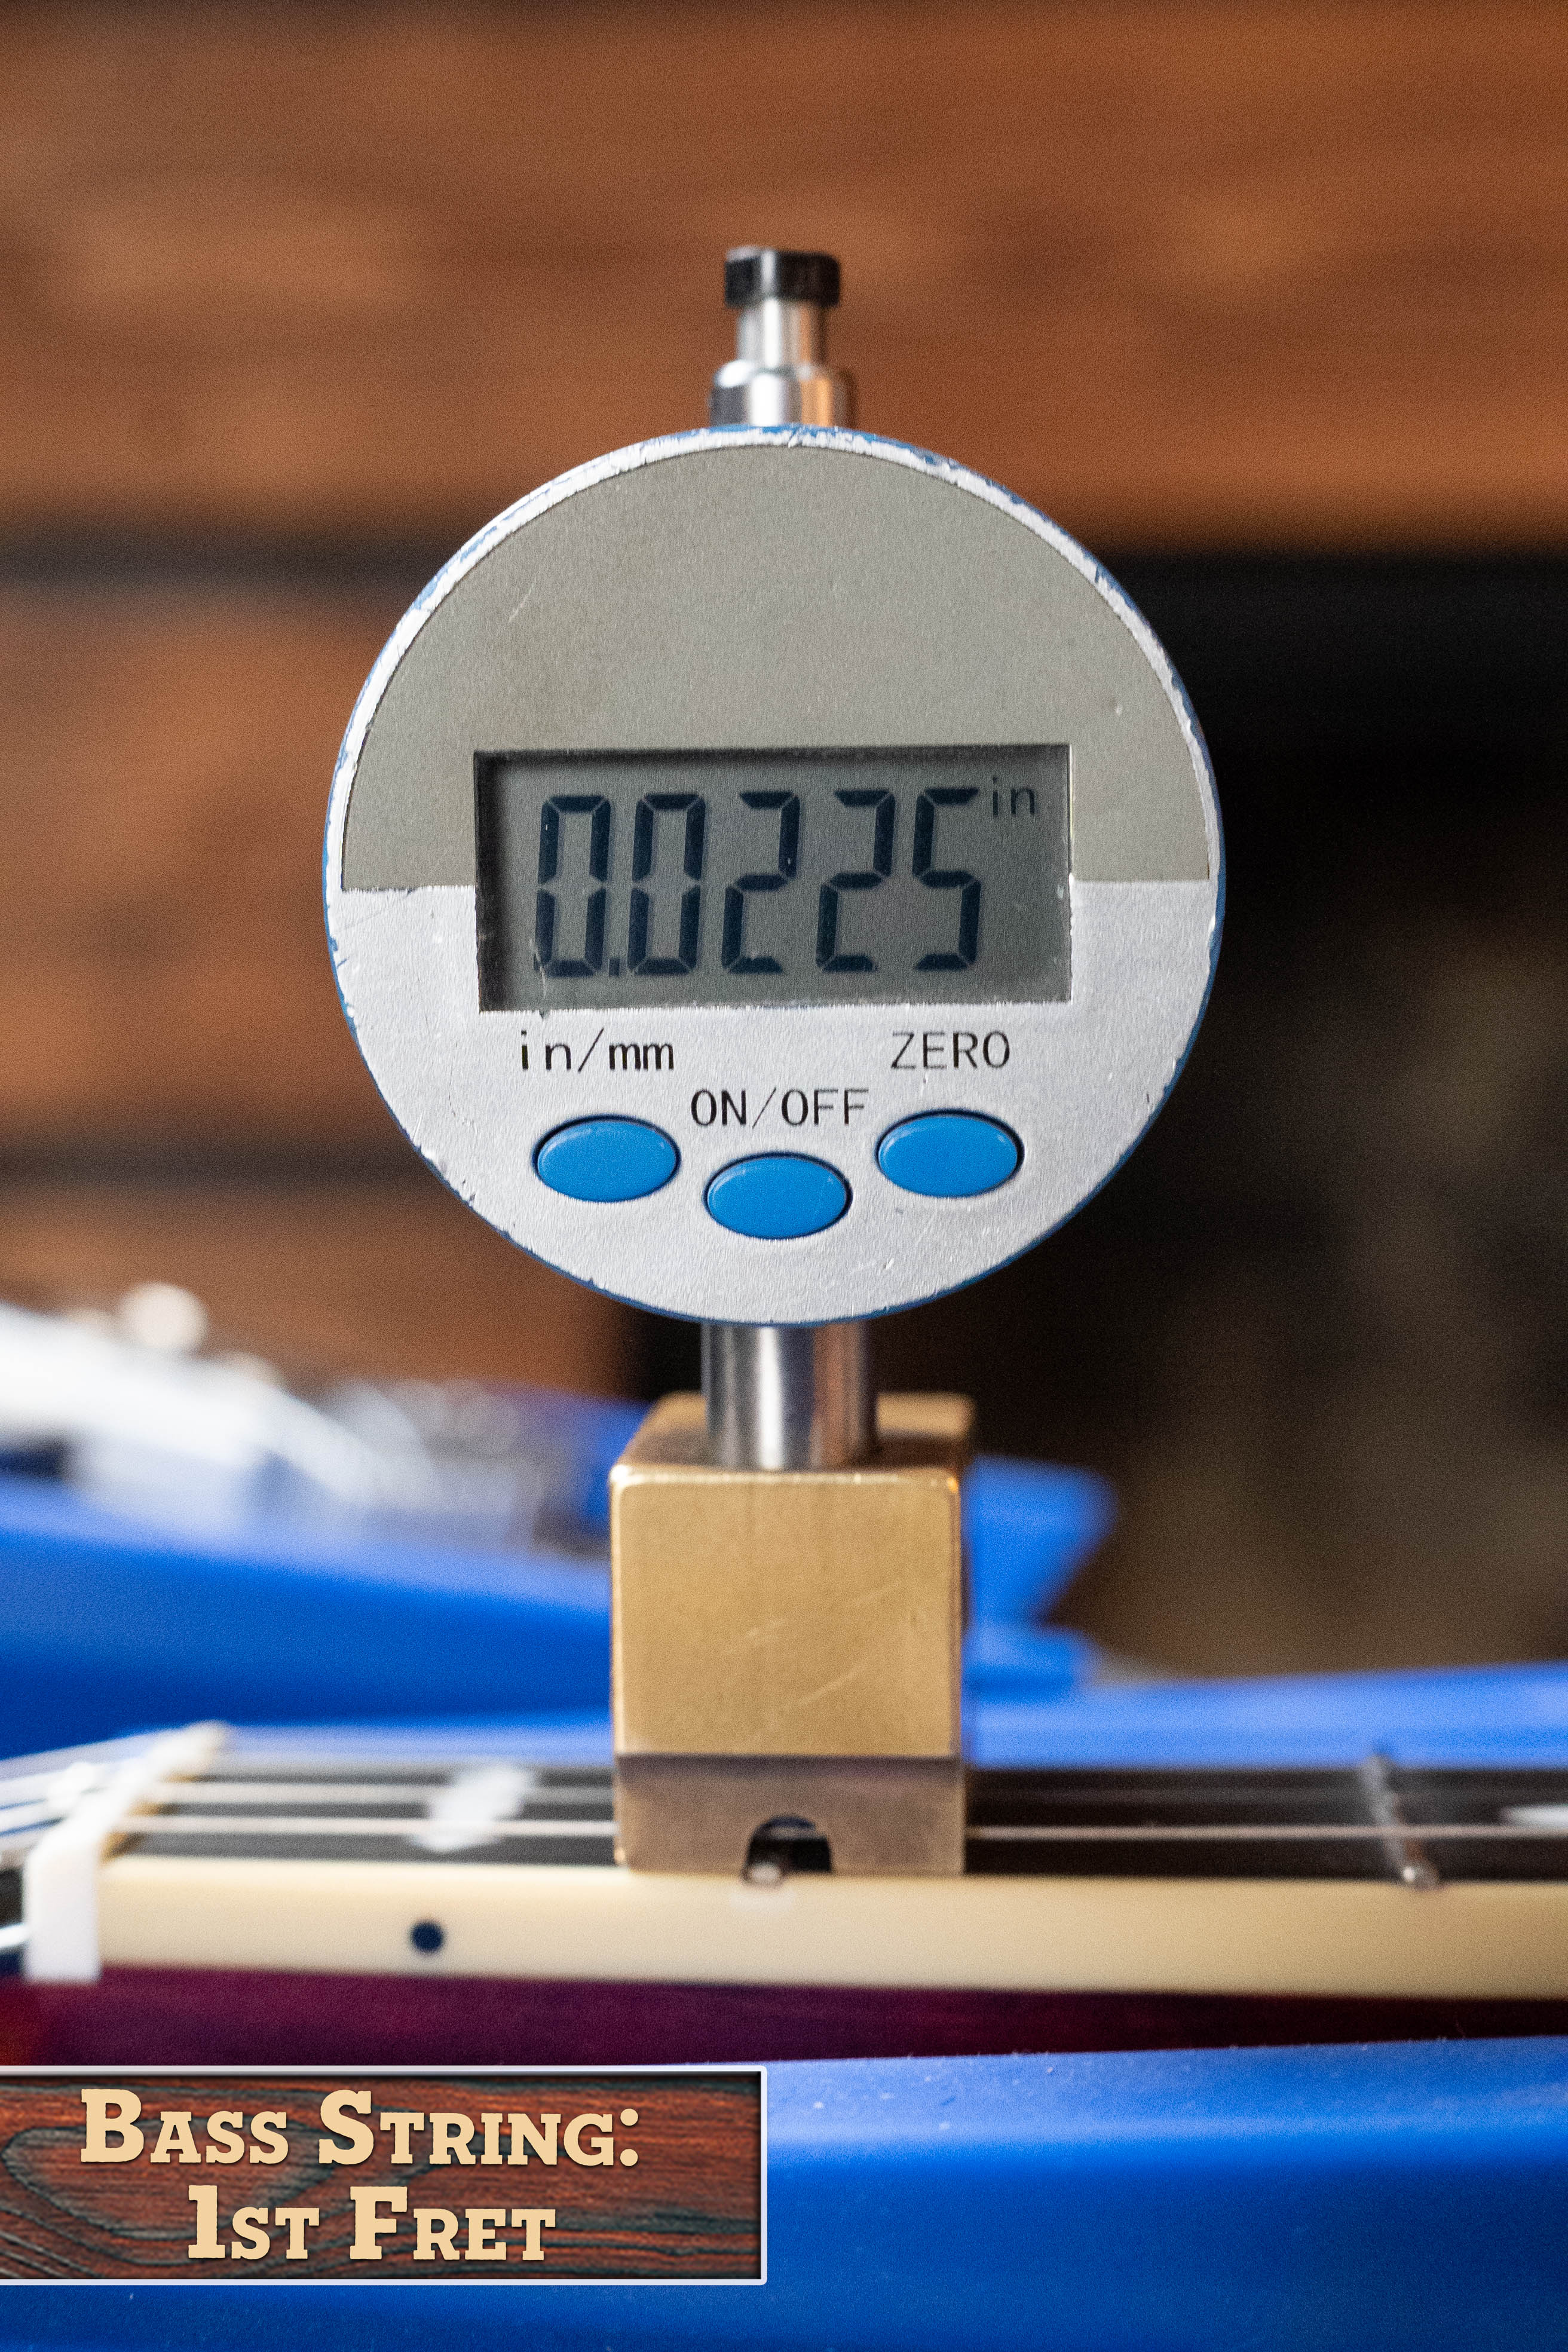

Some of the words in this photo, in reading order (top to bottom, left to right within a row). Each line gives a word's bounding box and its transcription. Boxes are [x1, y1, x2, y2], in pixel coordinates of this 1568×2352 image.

[533, 788, 981, 978] 0.0225
[992, 776, 1036, 818] in
[520, 1027, 675, 1071] in/mm
[890, 1030, 1010, 1070] ZERO
[690, 1086, 869, 1129] ON/OFF
